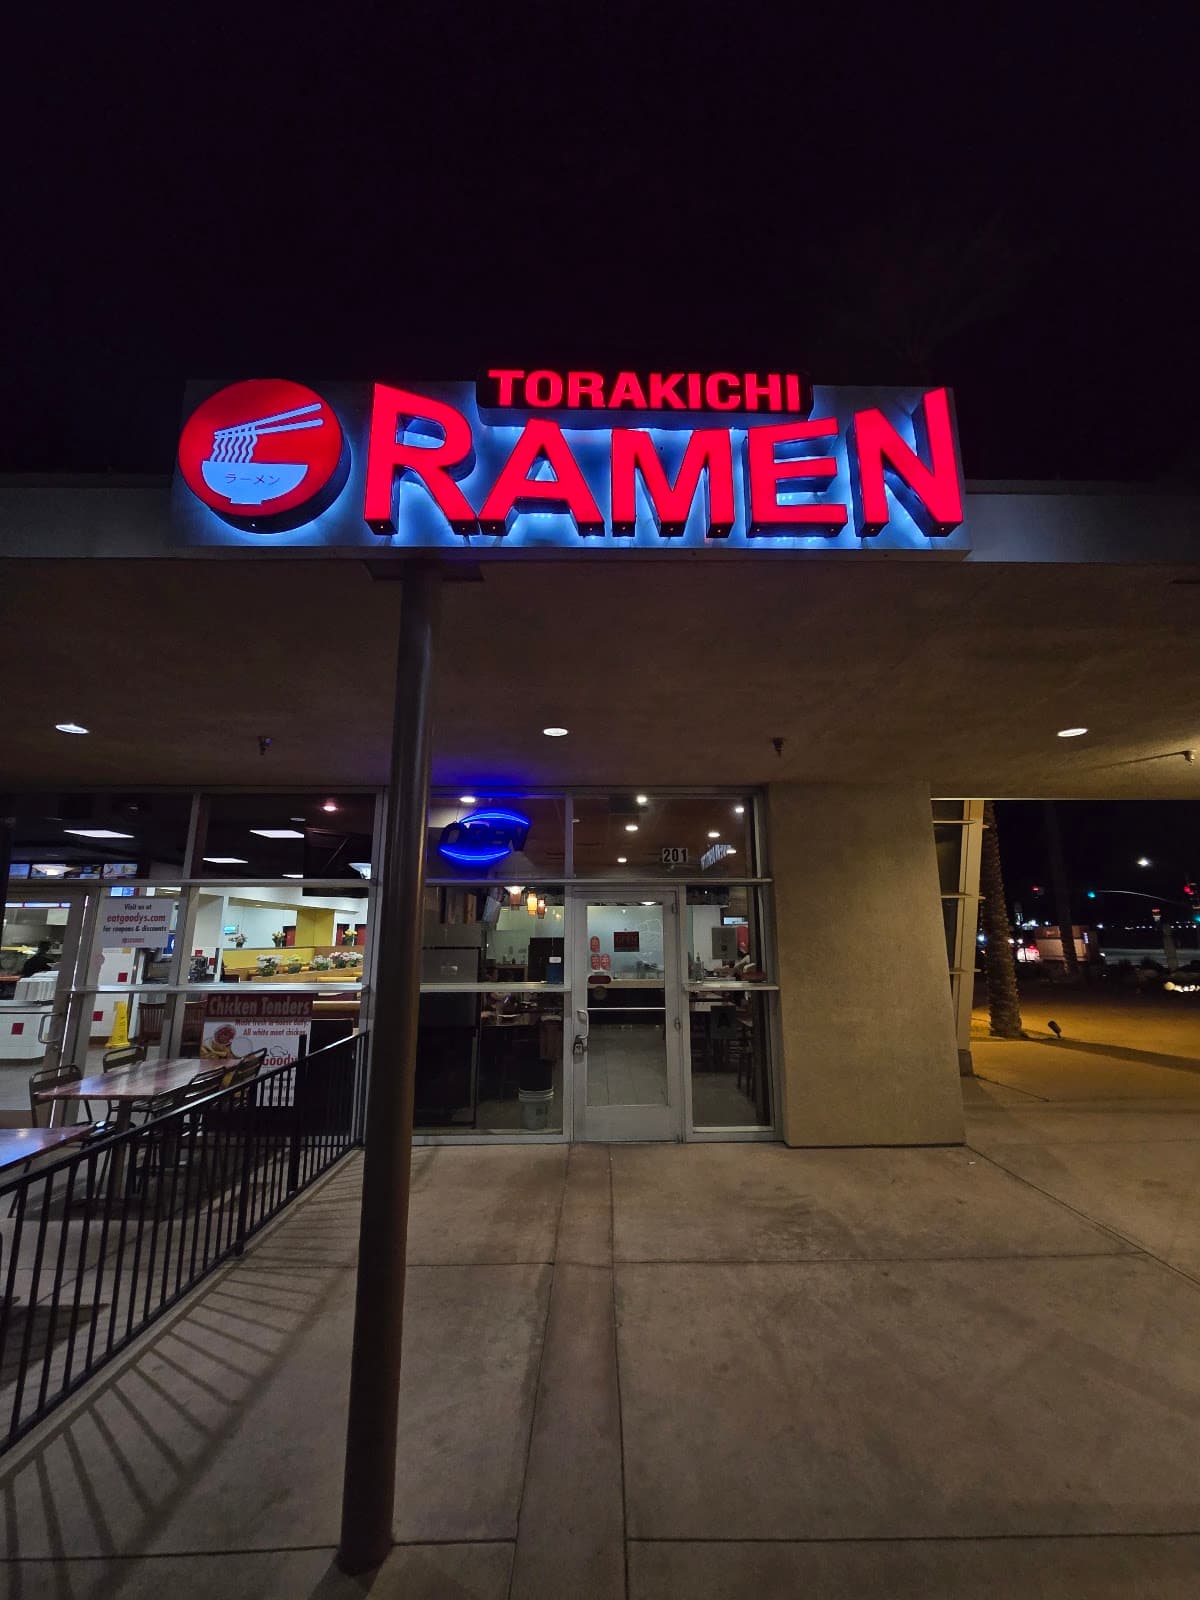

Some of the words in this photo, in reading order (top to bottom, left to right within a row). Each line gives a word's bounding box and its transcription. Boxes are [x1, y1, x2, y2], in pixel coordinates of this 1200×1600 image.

[488, 370, 800, 411] TORAKICHI
[363, 383, 964, 532] RAMEN
[225, 473, 280, 486] ラーメン
[663, 848, 687, 862] 201
[124, 903, 137, 911] Visit
[146, 903, 152, 911] at
[106, 912, 166, 924] eatgoodys.com
[208, 995, 257, 1015] Chicken
[261, 995, 310, 1015] Tenders
